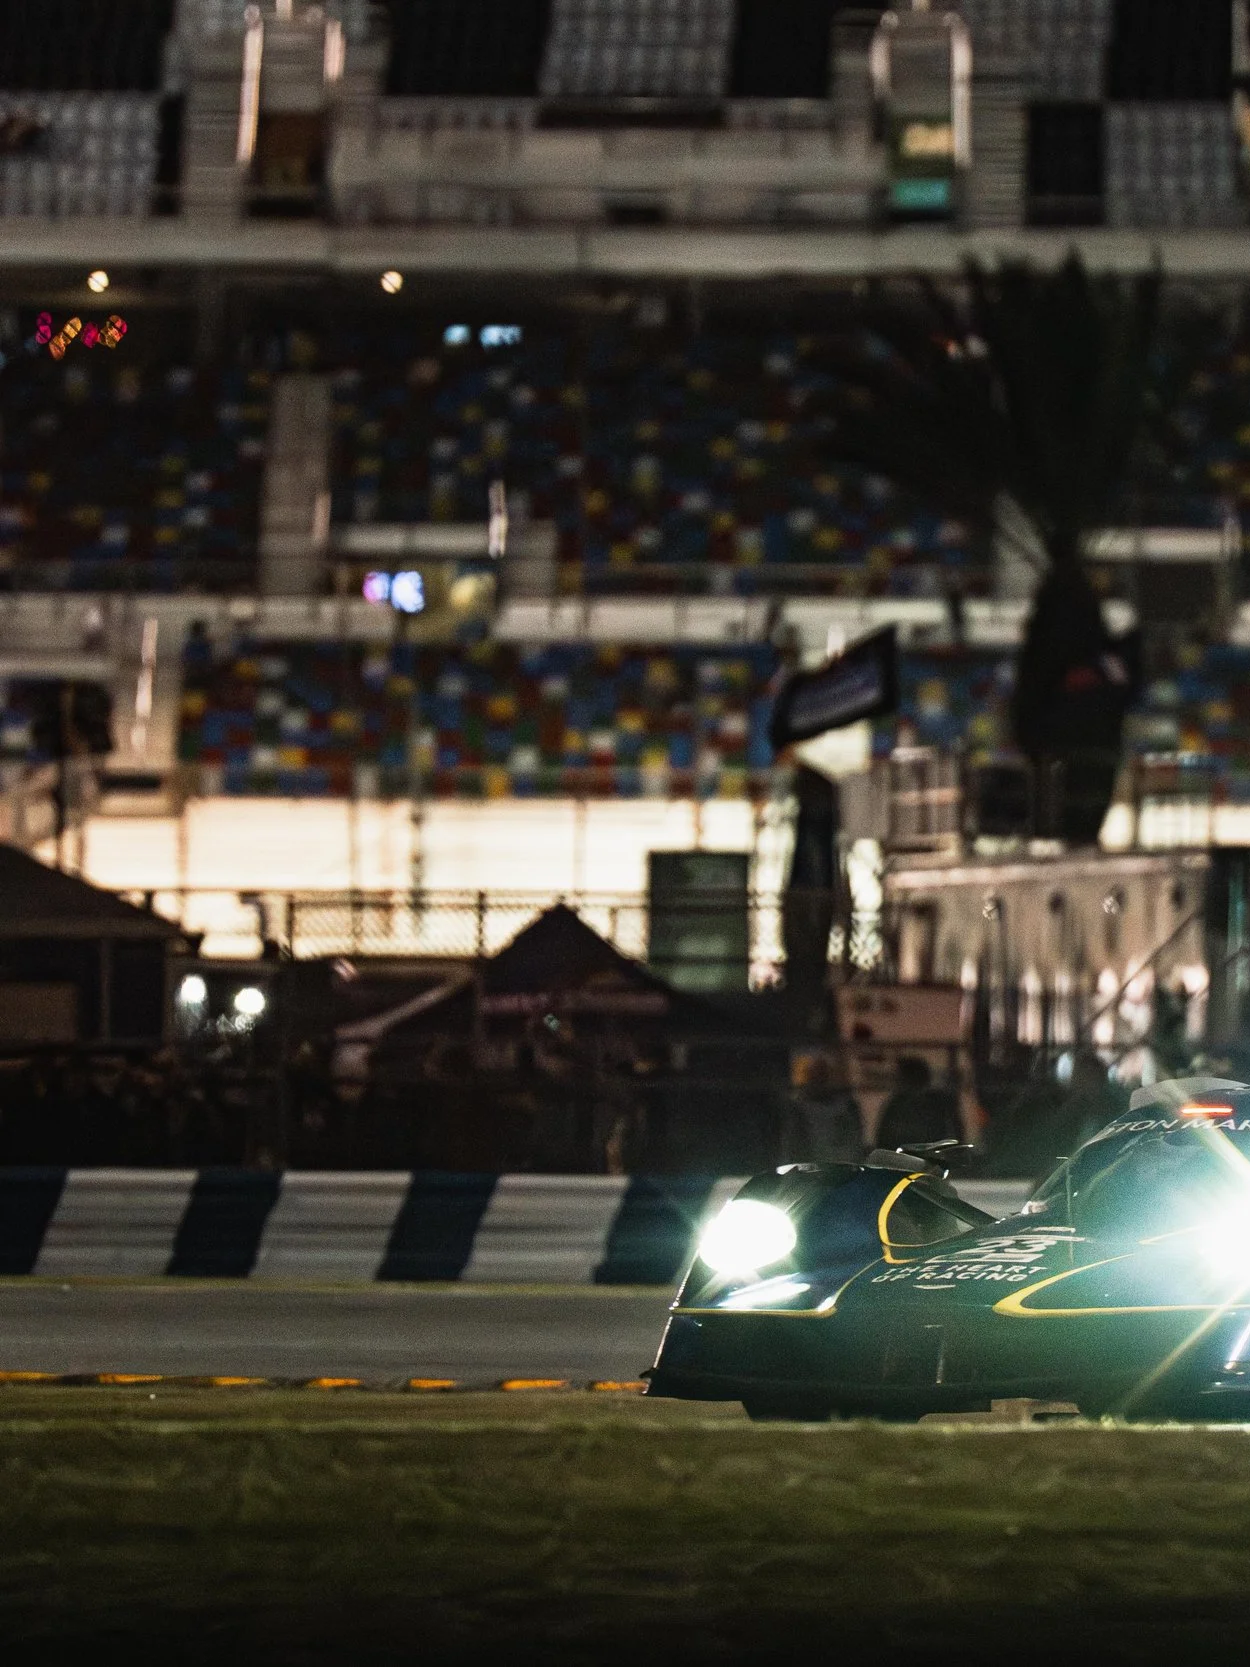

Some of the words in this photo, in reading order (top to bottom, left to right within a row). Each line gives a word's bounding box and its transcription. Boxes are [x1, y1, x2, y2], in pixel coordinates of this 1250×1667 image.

[884, 1263, 939, 1274] THE
[943, 1263, 1048, 1274] HEART
[871, 1272, 911, 1283] OF
[916, 1271, 1028, 1283] RACING
